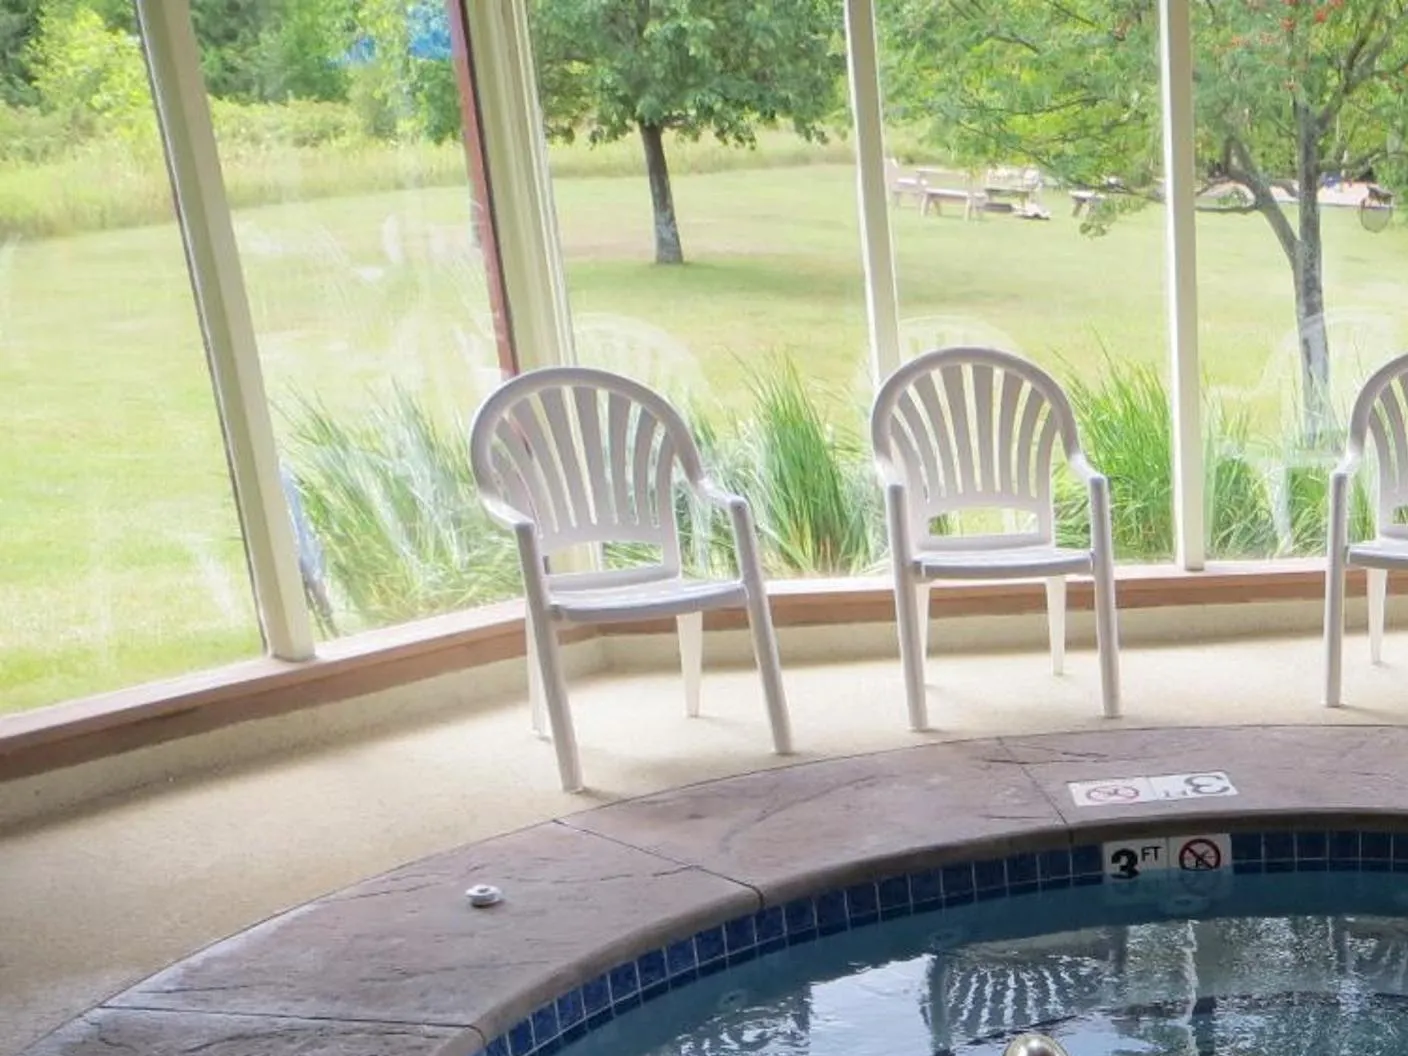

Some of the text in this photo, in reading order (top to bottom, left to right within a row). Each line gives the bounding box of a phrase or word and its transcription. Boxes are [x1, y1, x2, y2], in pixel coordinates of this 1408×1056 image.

[1184, 774, 1230, 795] 3
[1111, 846, 1163, 880] 3 FT
